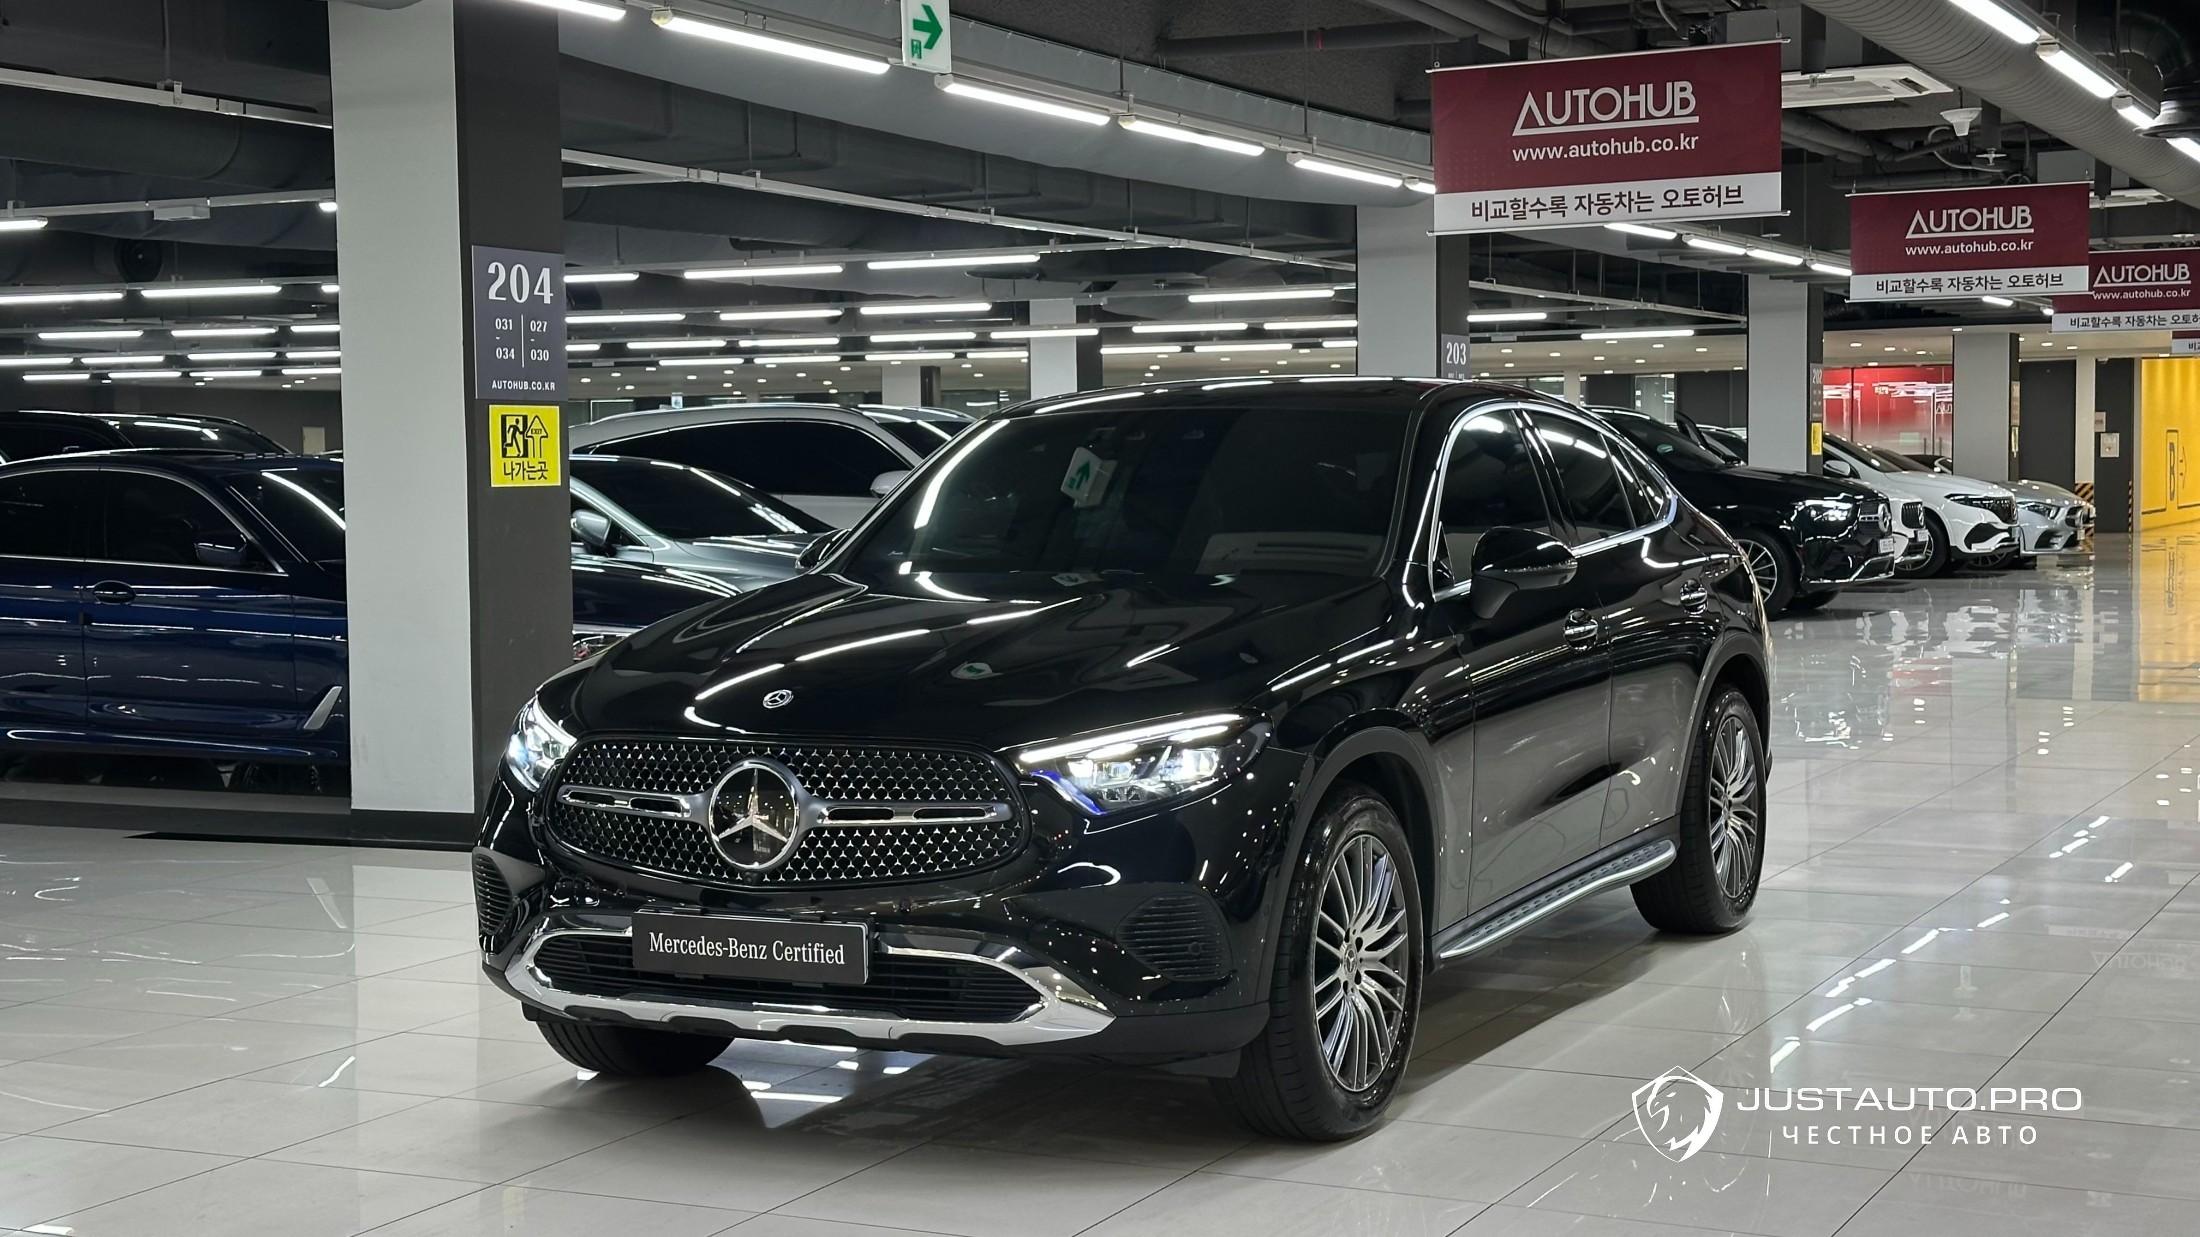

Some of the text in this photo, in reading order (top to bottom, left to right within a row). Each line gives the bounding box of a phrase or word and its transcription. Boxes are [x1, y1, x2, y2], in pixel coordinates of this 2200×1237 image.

[1512, 80, 1699, 136] AUTOHUB
[1512, 133, 1699, 162] www.autohub.co.kr
[1471, 185, 1744, 222] 비교할수록 자동차는 오토허브
[1905, 205, 2034, 239] AUTOHUB
[1905, 238, 2034, 256] www.autohub.co.kr
[487, 261, 553, 304] 204
[1876, 273, 2064, 294] 비교할수록 자동차는 오토허브
[2093, 263, 2191, 287] AUTOHUB
[2092, 288, 2191, 300] www.autohub.co.kr
[495, 318, 513, 331] 031
[530, 320, 548, 332] 027
[2070, 316, 2122, 329] 비교할수록
[2125, 315, 2168, 328] 자동차는
[496, 347, 515, 360] 034
[530, 349, 550, 362] 030
[1446, 341, 1467, 365] 203
[491, 379, 556, 392] AUTOHUB.CO.KR
[503, 460, 549, 481] 나가는곳
[649, 932, 845, 965] Mercedes-Benz Certified
